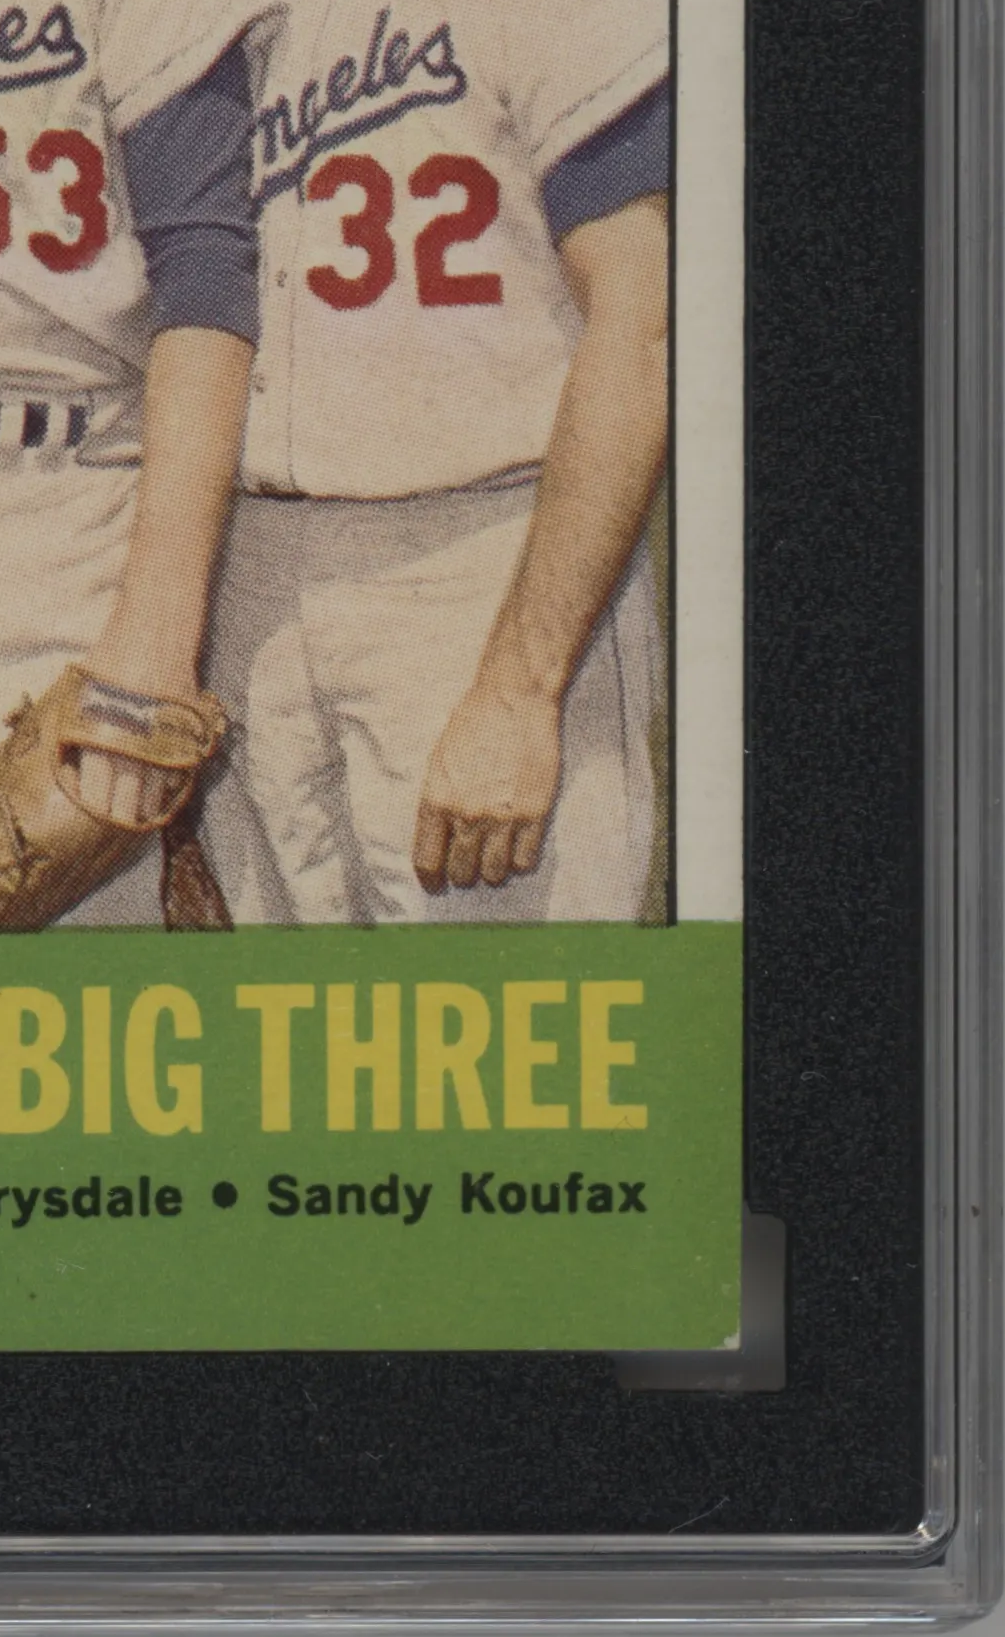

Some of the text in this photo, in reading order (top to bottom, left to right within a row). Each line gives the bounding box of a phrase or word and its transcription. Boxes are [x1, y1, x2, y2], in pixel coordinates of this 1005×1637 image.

[253, 5, 467, 205] ngeles
[306, 153, 502, 311] 32
[236, 979, 648, 1132] THREE
[267, 1174, 432, 1224] Sandy
[461, 1172, 647, 1215] Koufax
